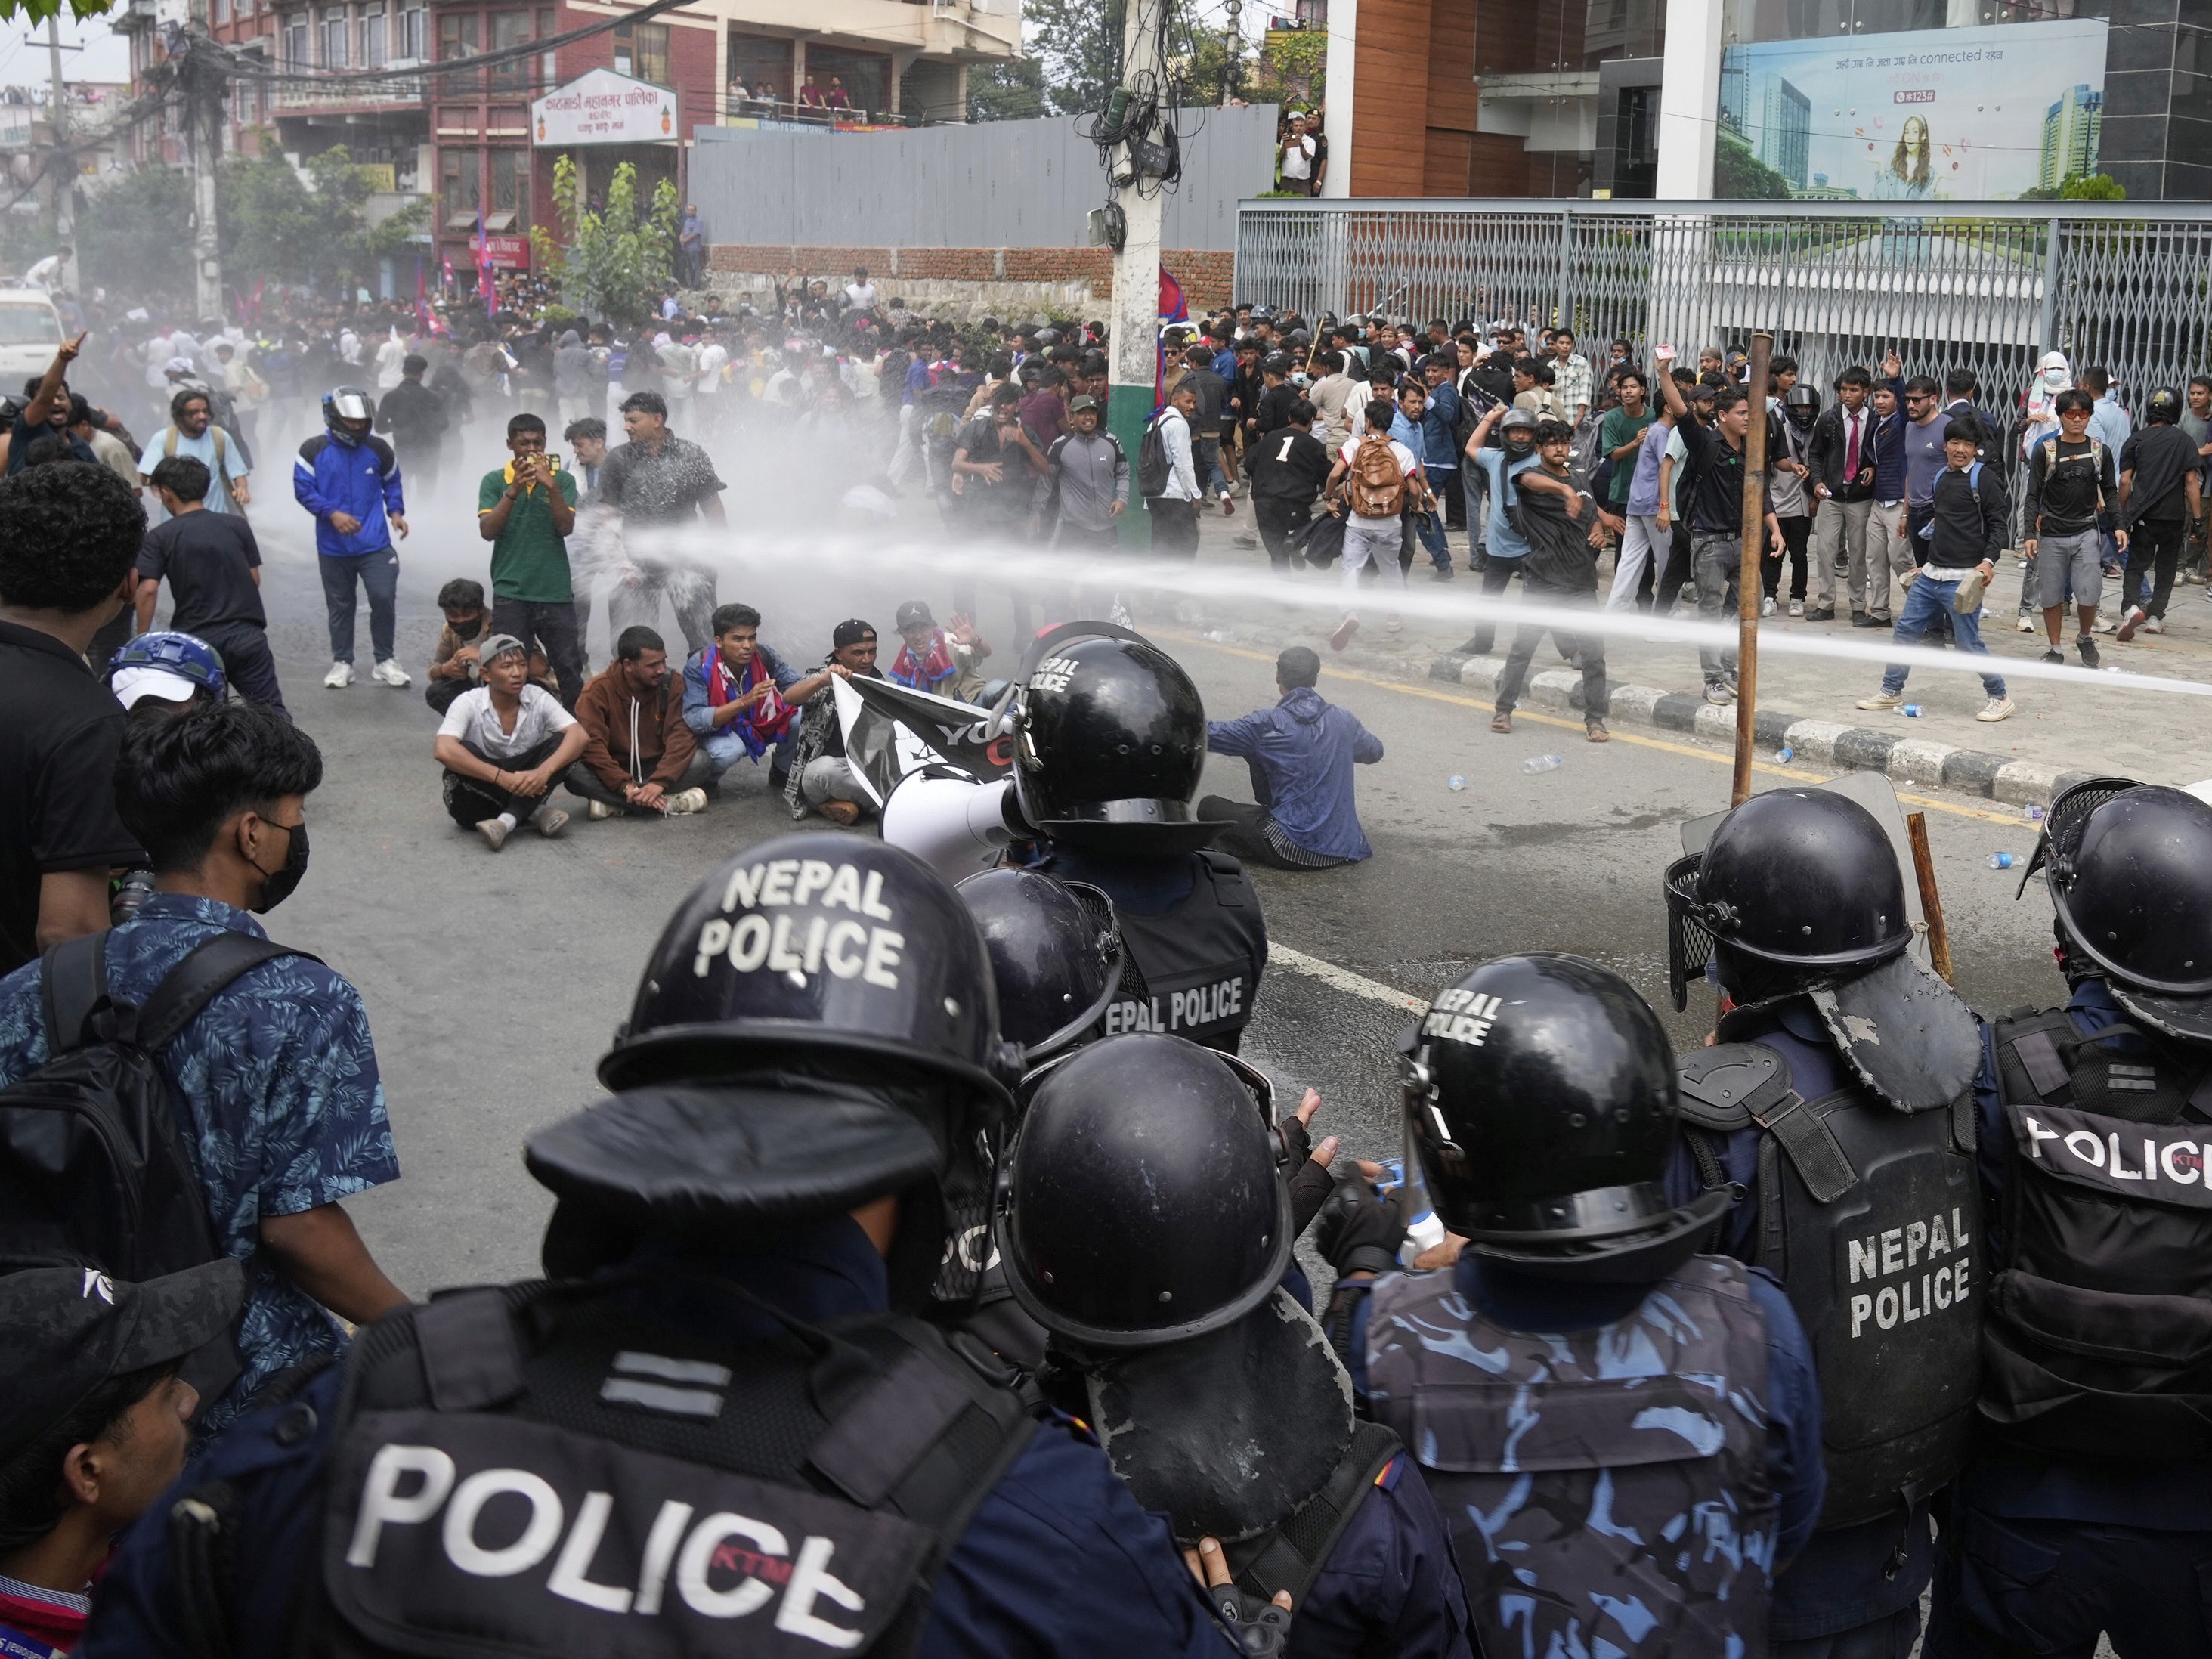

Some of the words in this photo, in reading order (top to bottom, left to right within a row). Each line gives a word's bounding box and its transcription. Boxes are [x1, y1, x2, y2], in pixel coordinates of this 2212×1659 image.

[1920, 49, 1982, 64] connected
[584, 94, 621, 110] महानगर
[625, 87, 657, 106] पालिका
[1276, 436, 1294, 462] 1
[721, 859, 893, 921] NEPAL
[693, 914, 905, 990] POLICE
[1106, 996, 1165, 1036] EPAL
[1171, 976, 1242, 1030] POLICE
[2173, 1154, 2204, 1170] KTM
[1848, 1208, 1969, 1284] NEPAL
[1850, 1257, 1970, 1339] POLICE
[346, 1444, 865, 1650] POLICE
[710, 1542, 795, 1586] KTM
